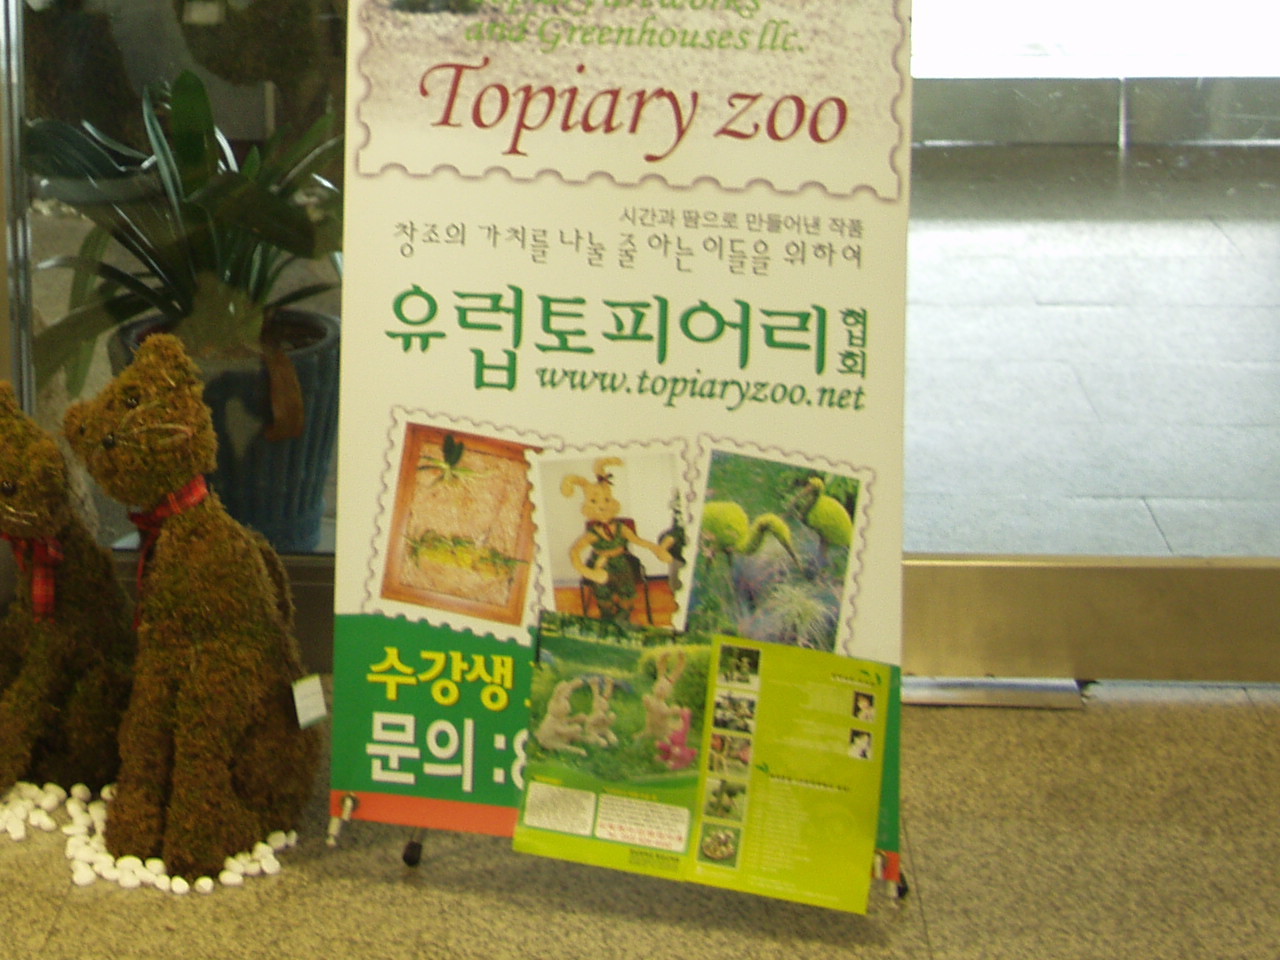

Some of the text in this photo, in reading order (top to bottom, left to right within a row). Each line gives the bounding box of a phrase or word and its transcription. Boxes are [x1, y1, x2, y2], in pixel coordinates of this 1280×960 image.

[464, 12, 537, 43] and
[537, 15, 751, 54] Greenhouses
[419, 56, 849, 163] Topiary zoo
[393, 220, 863, 277] 창조의 가치를 나눌 줄 아는 이들을 위하여
[619, 205, 864, 239] 시간과 땀으로 만들어낸 작품
[384, 282, 830, 393] 유럽토피어리
[535, 365, 867, 413] www.topiaryzoo.net
[366, 646, 515, 712] 수강생
[365, 711, 475, 793] 문의
